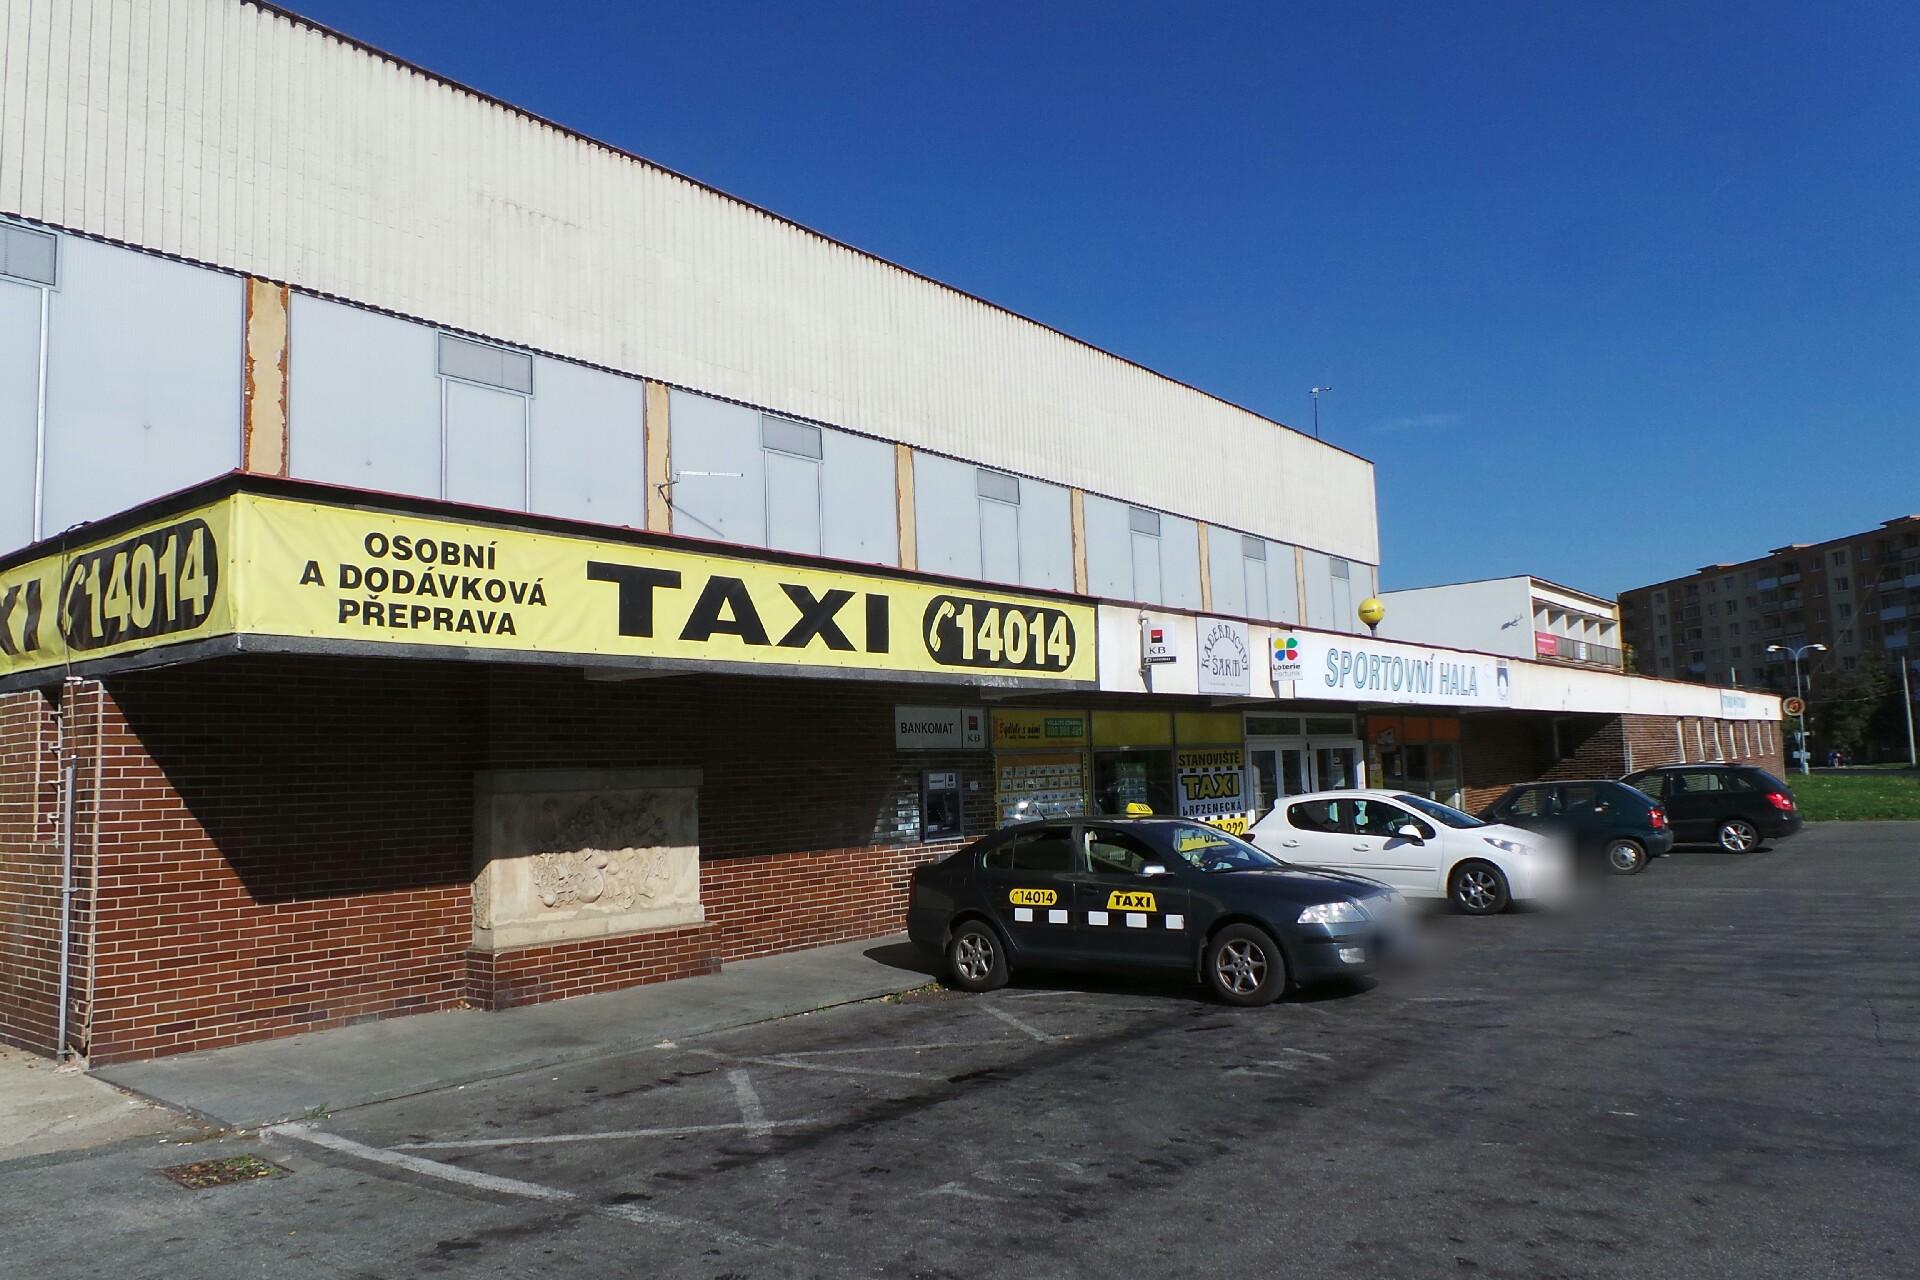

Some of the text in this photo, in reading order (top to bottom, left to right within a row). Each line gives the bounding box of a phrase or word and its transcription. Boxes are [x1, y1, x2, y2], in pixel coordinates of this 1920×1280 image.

[364, 532, 498, 570] OSOBNÍ
[85, 527, 209, 638] 14014
[299, 559, 547, 607] A DODÁVKOVÁ
[338, 594, 517, 636] PŘEPRAVA
[586, 560, 1070, 667] TAXI 14014
[1149, 646, 1166, 655] KB
[1272, 662, 1301, 671] Loterie
[1324, 647, 1478, 697] SPORTOVNÍ HALA
[900, 722, 954, 734] BANKOMAT
[967, 733, 981, 743] KB
[1179, 750, 1240, 766] STANOVIŠTĚ
[1182, 773, 1239, 800] TAXI
[1020, 891, 1054, 904] 14014
[1113, 894, 1151, 908] TAXI
